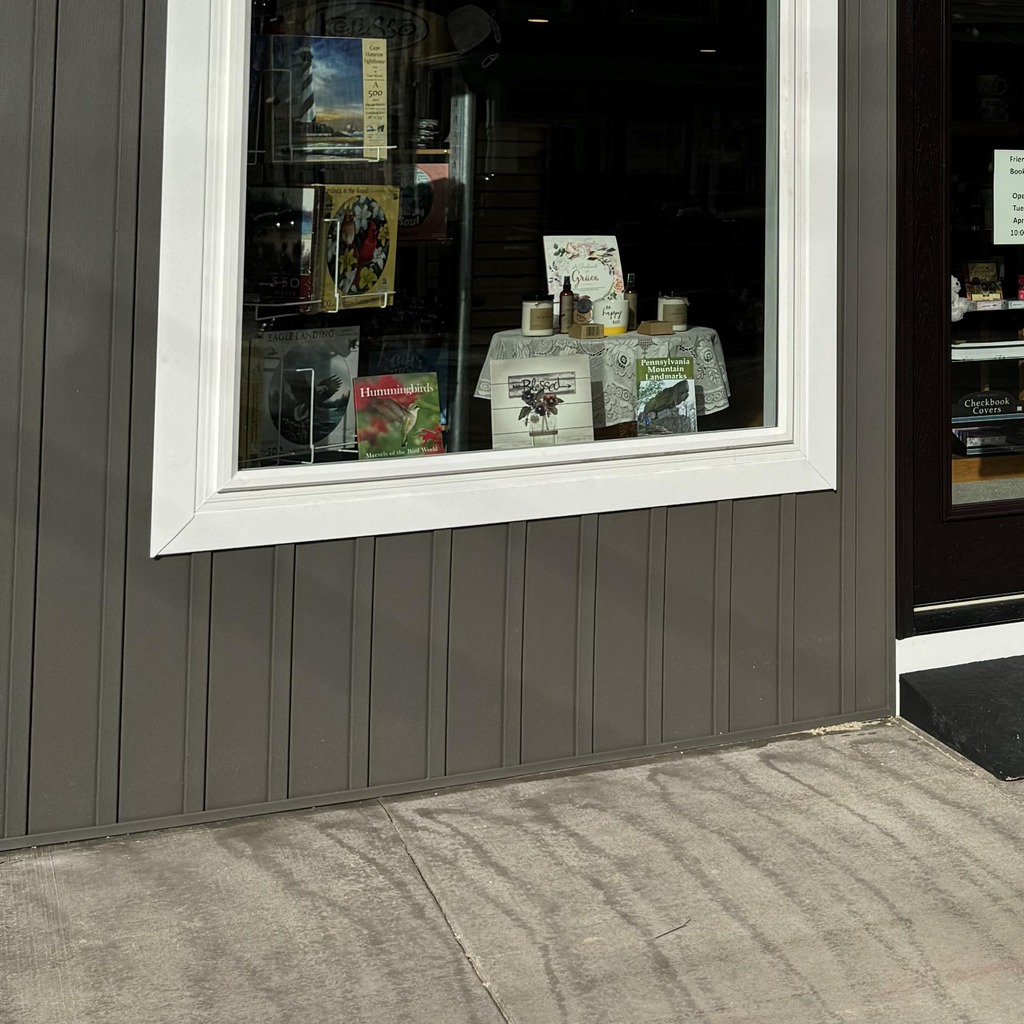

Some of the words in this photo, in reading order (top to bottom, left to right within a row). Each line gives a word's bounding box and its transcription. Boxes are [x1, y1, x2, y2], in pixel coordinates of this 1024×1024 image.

[368, 90, 383, 98] 500
[571, 269, 599, 287] Grace
[268, 332, 293, 342] EAGLE
[295, 329, 335, 340] LANDING
[640, 358, 690, 368] Pennsylvania
[647, 366, 684, 374] Mountain
[645, 373, 687, 381] Landmarks
[360, 382, 434, 398] Hummingbirds
[520, 377, 561, 393] Blessed
[964, 396, 1010, 408] Checkbook
[972, 406, 1002, 415] Covers
